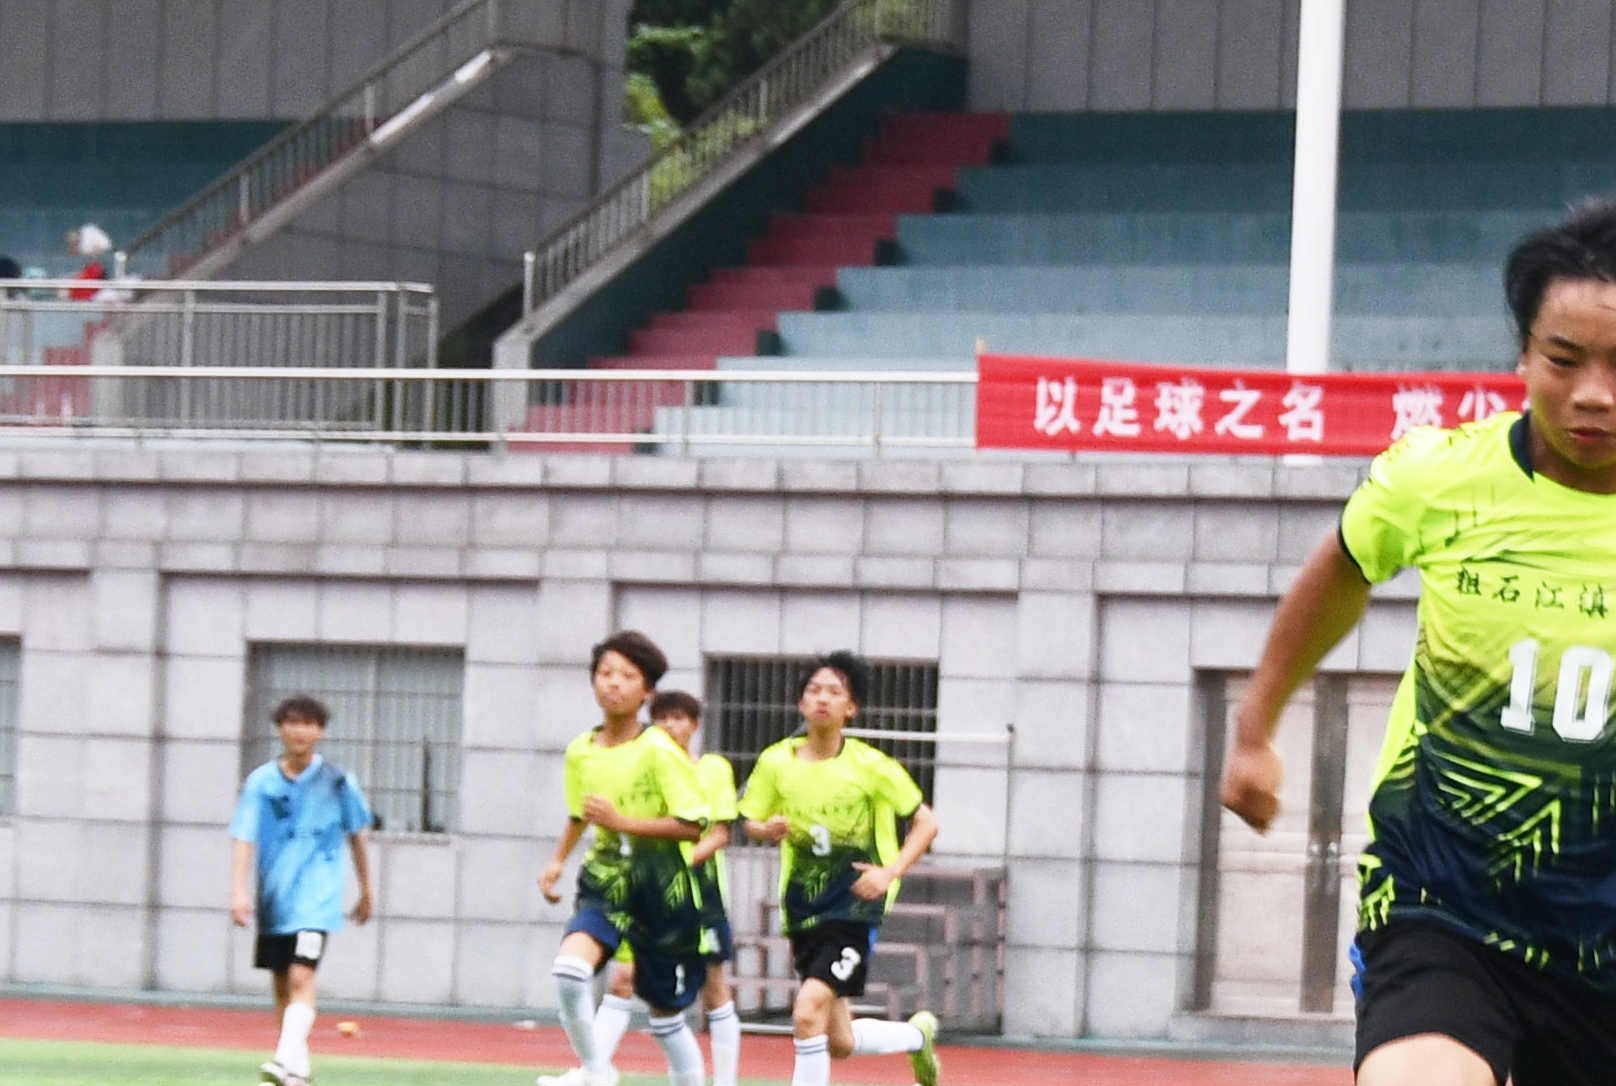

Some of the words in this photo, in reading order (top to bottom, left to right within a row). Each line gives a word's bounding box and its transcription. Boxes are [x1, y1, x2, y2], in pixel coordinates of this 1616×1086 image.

[1033, 376, 1325, 441] 以足球之名
[1501, 638, 1616, 744] 10
[809, 824, 831, 857] 3
[831, 946, 861, 981] 3
